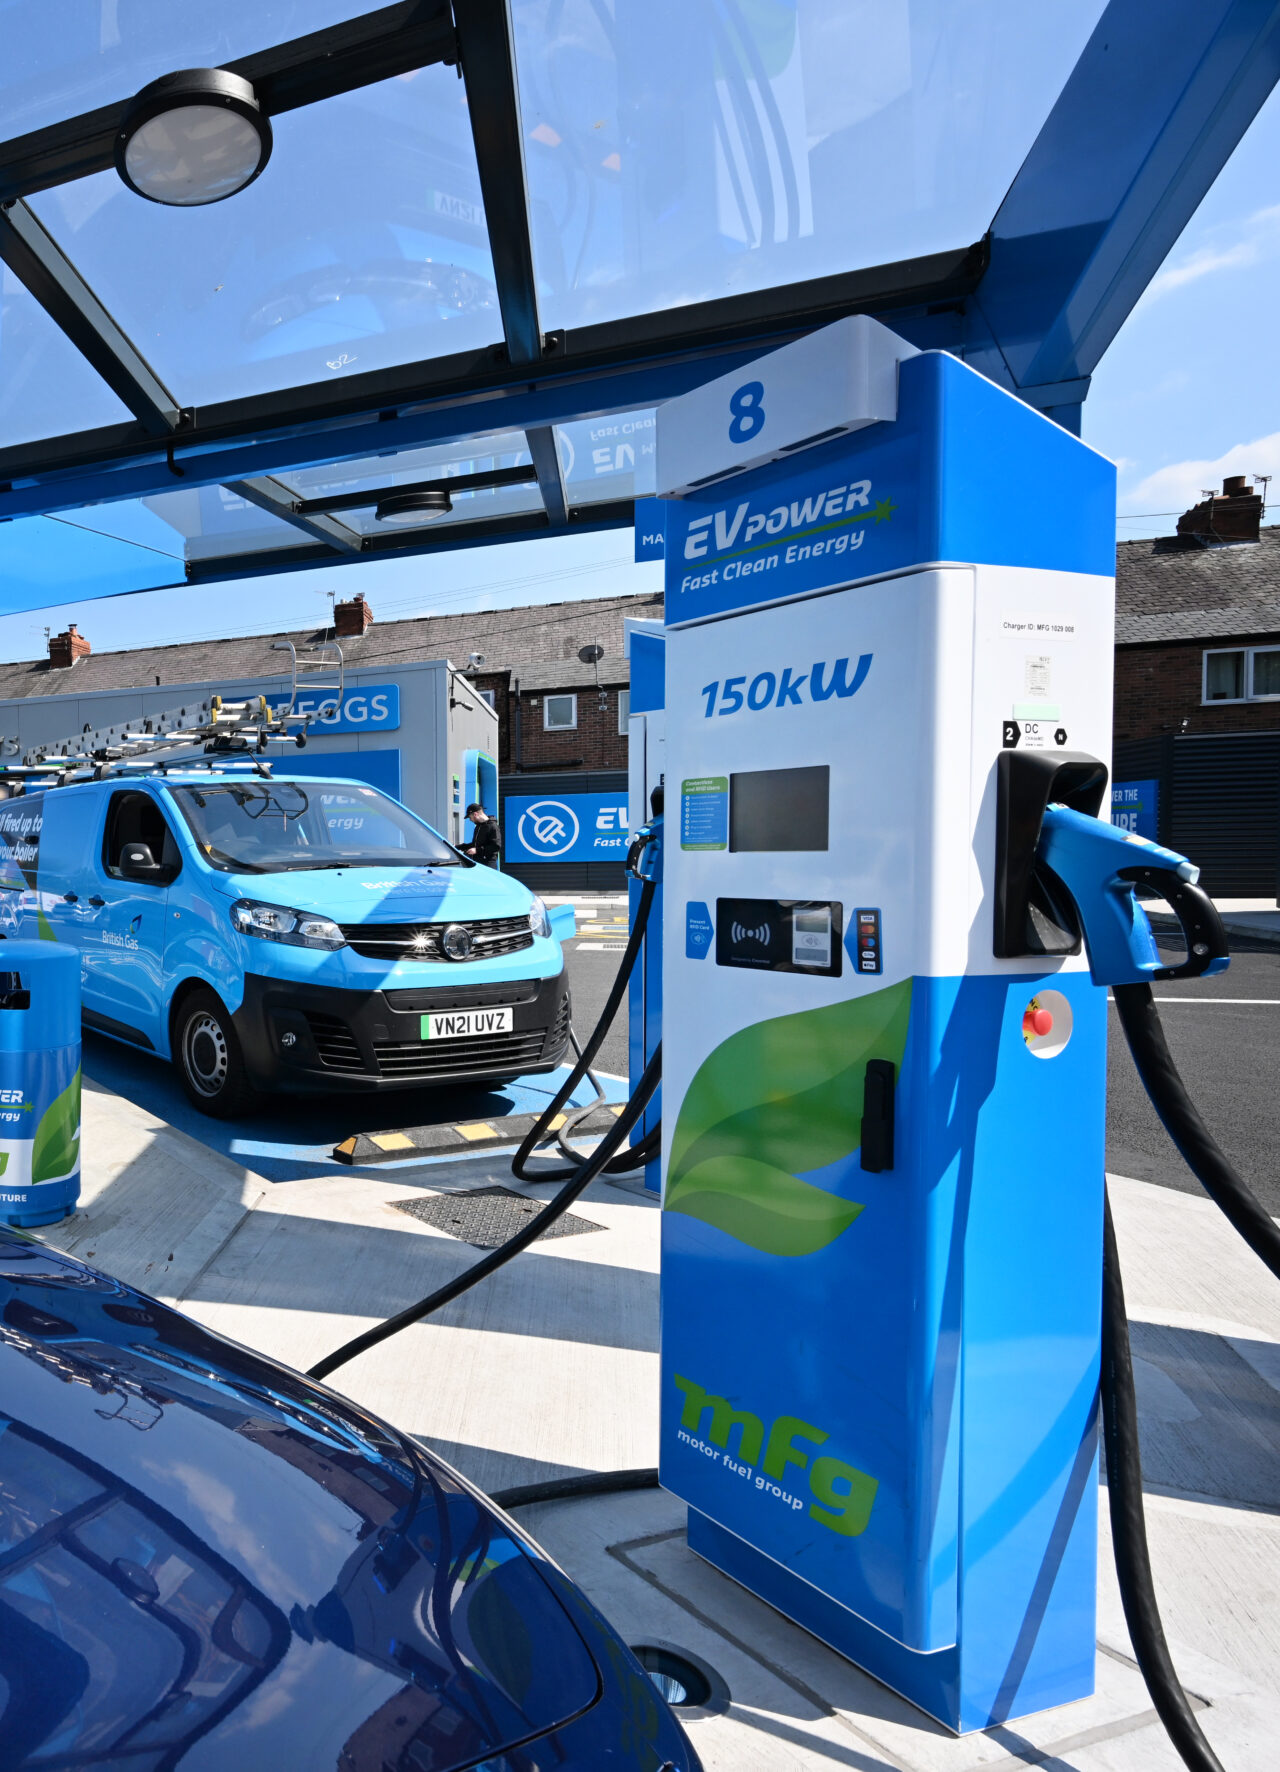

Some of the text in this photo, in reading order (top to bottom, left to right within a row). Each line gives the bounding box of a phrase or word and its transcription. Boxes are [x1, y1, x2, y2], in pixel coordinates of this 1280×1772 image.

[728, 381, 766, 444] 8
[681, 530, 865, 594] Fast Clean Energy
[1003, 622, 1026, 630] Charger
[701, 653, 874, 718] 150kW
[278, 694, 389, 726] EGGS
[1006, 723, 1038, 740] 2 DC
[1124, 789, 1138, 801] THE
[3, 813, 24, 832] fired
[21, 818, 32, 836] up
[32, 814, 43, 832] to
[328, 818, 364, 830] ergy
[14, 841, 38, 862] boiler
[594, 837, 622, 847] Fast
[102, 930, 139, 950] British Gas
[435, 1012, 505, 1035] VN21 UVZ
[677, 1429, 804, 1510] motor fuel group
